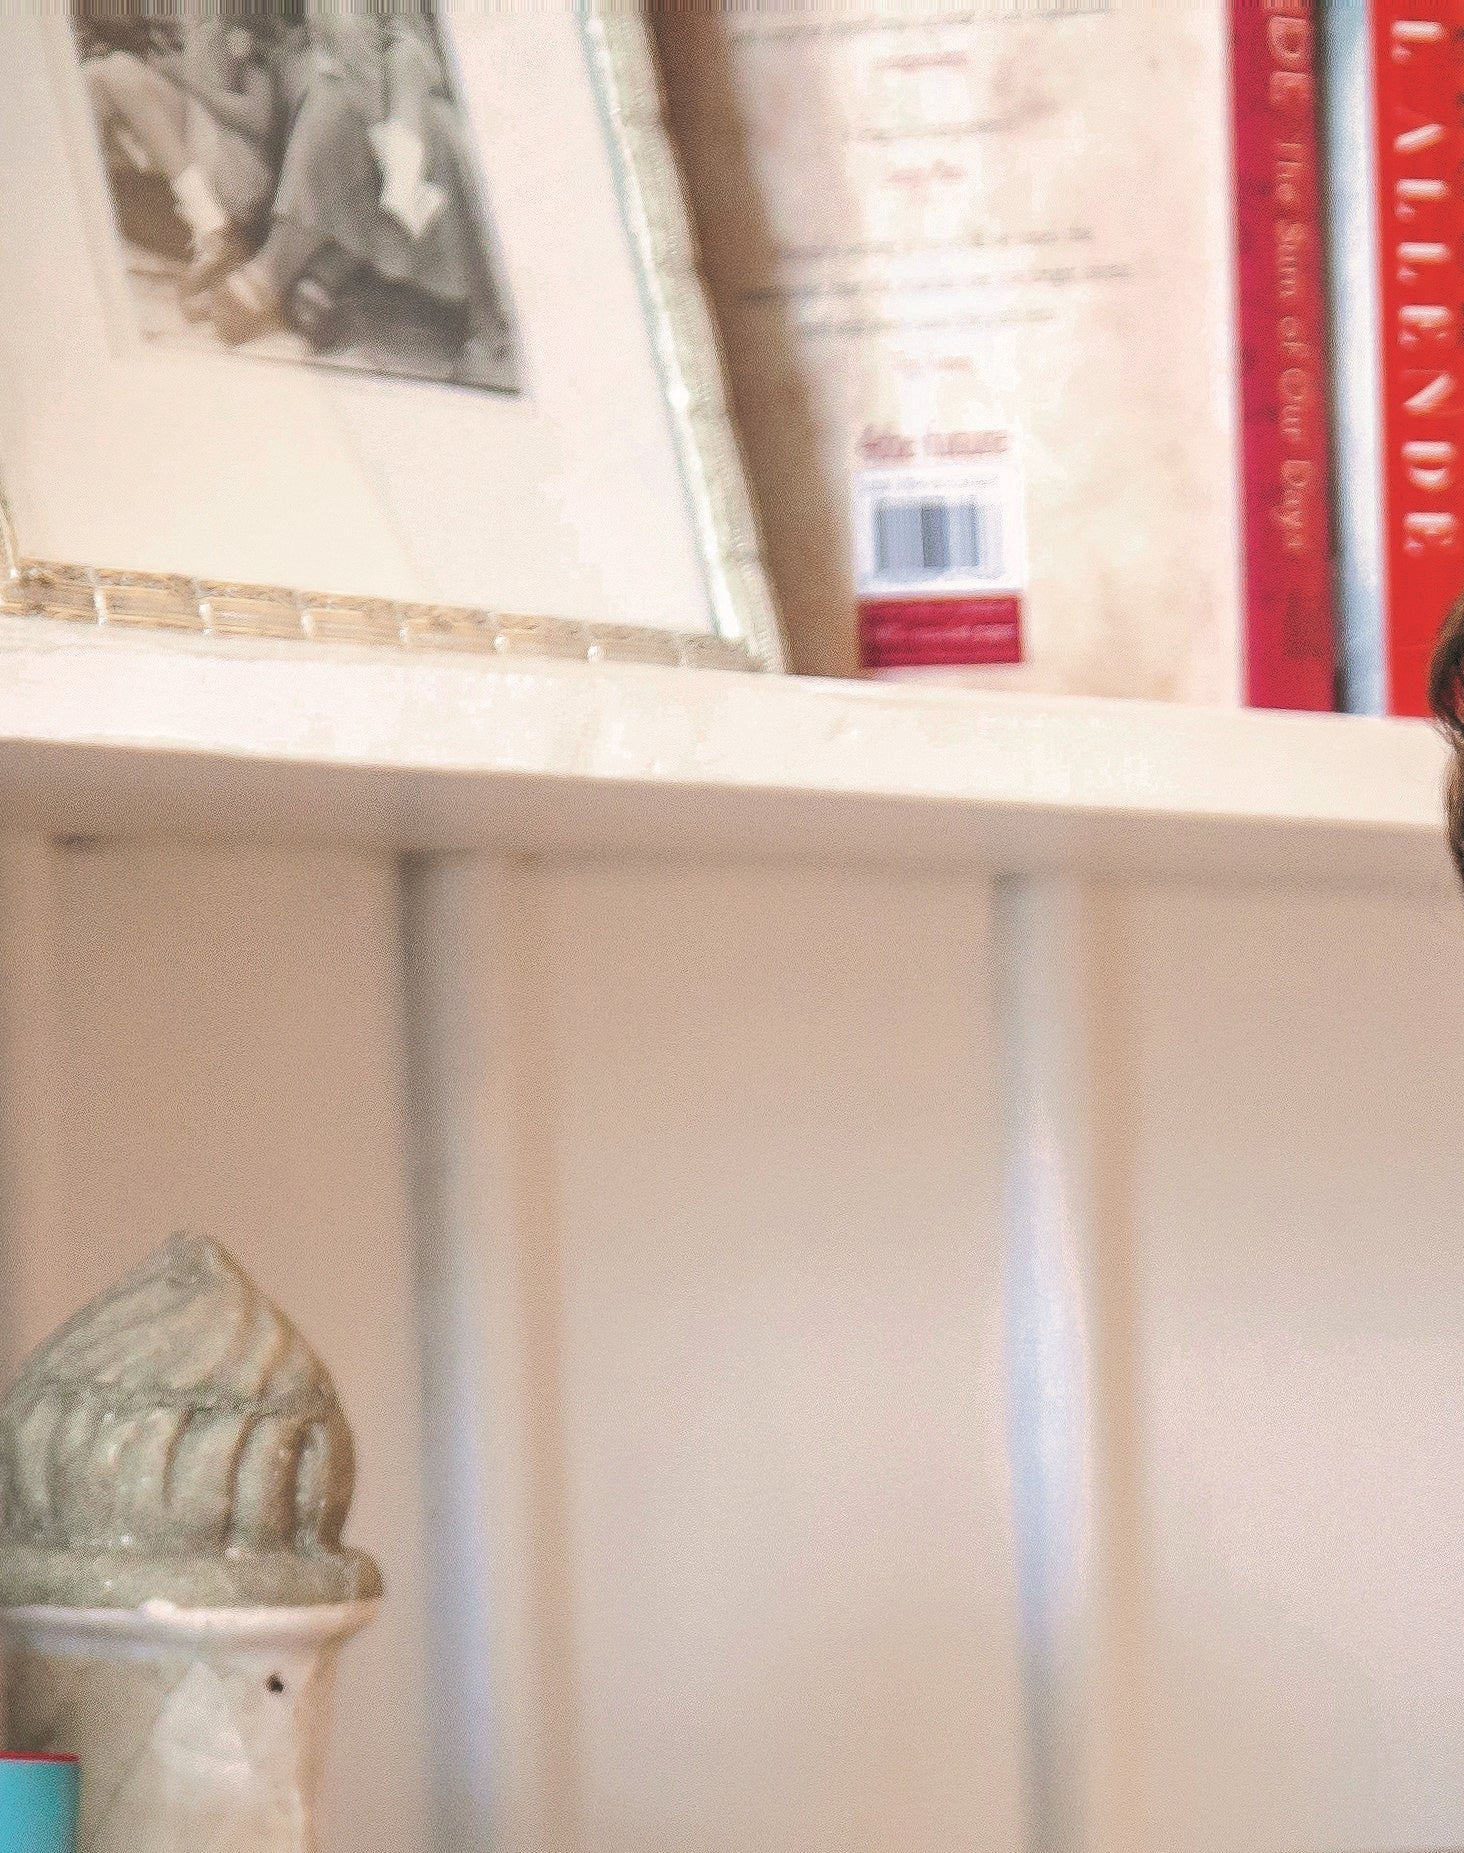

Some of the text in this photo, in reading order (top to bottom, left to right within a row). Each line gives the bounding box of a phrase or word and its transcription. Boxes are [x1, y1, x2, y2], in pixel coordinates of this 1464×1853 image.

[1277, 220, 1311, 299] Sum
[1278, 314, 1312, 358] of
[1394, 105, 1459, 558] ALLENDE
[1279, 367, 1312, 442] Our
